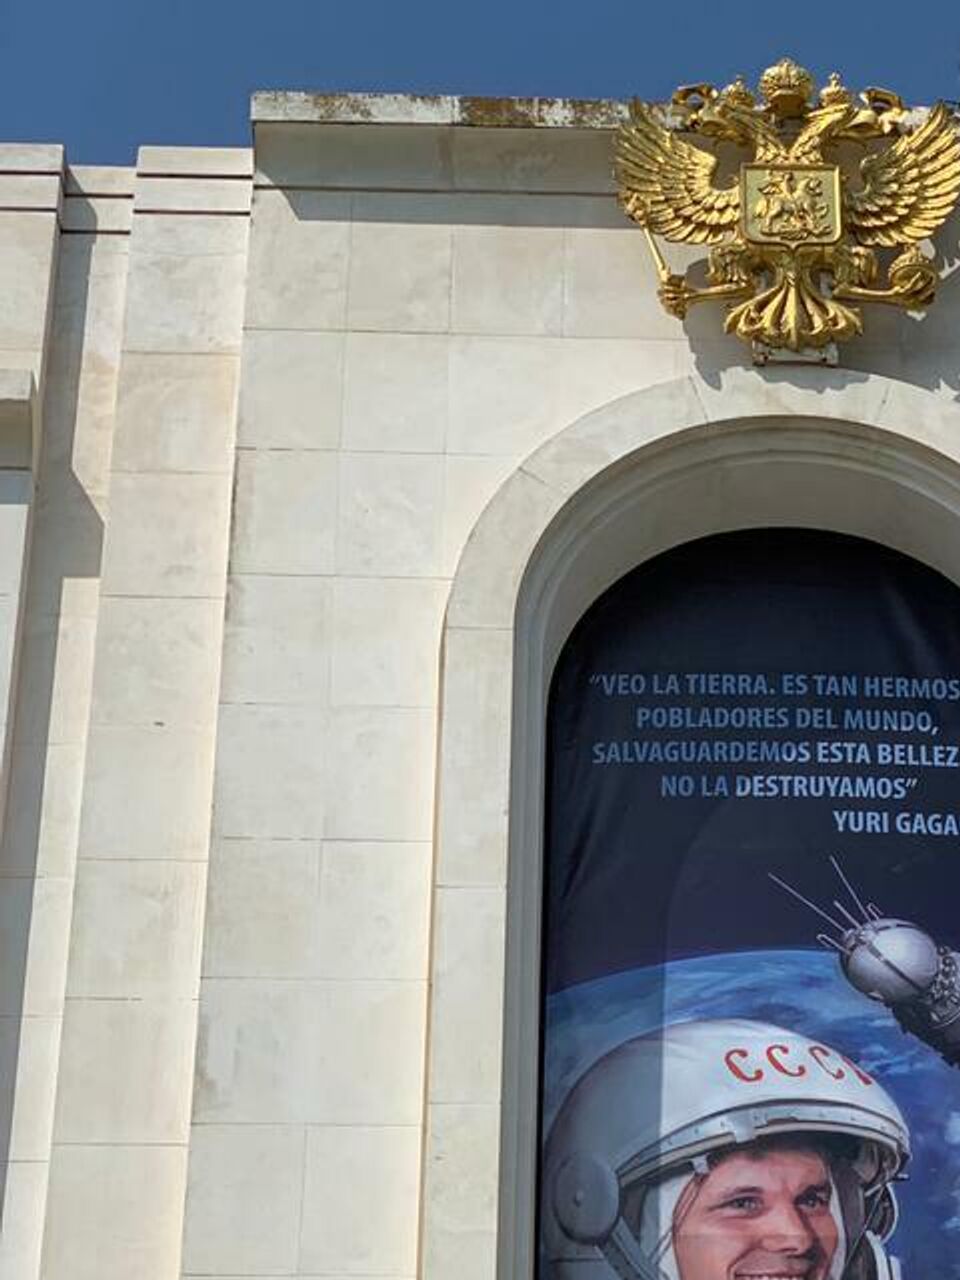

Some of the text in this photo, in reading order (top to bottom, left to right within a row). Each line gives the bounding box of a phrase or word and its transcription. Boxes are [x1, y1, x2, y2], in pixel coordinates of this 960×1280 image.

[653, 674, 680, 694] LA
[685, 674, 775, 695] TIERRA.
[783, 674, 808, 695] ES
[814, 675, 857, 696] TAN
[637, 707, 939, 735] POBLADORES DEL MUNDO,
[592, 741, 811, 763] SALVAGUARDEMOS
[817, 742, 870, 763] ESTA
[661, 775, 694, 797] NO
[702, 775, 728, 797] LA
[833, 810, 889, 833] YURI
